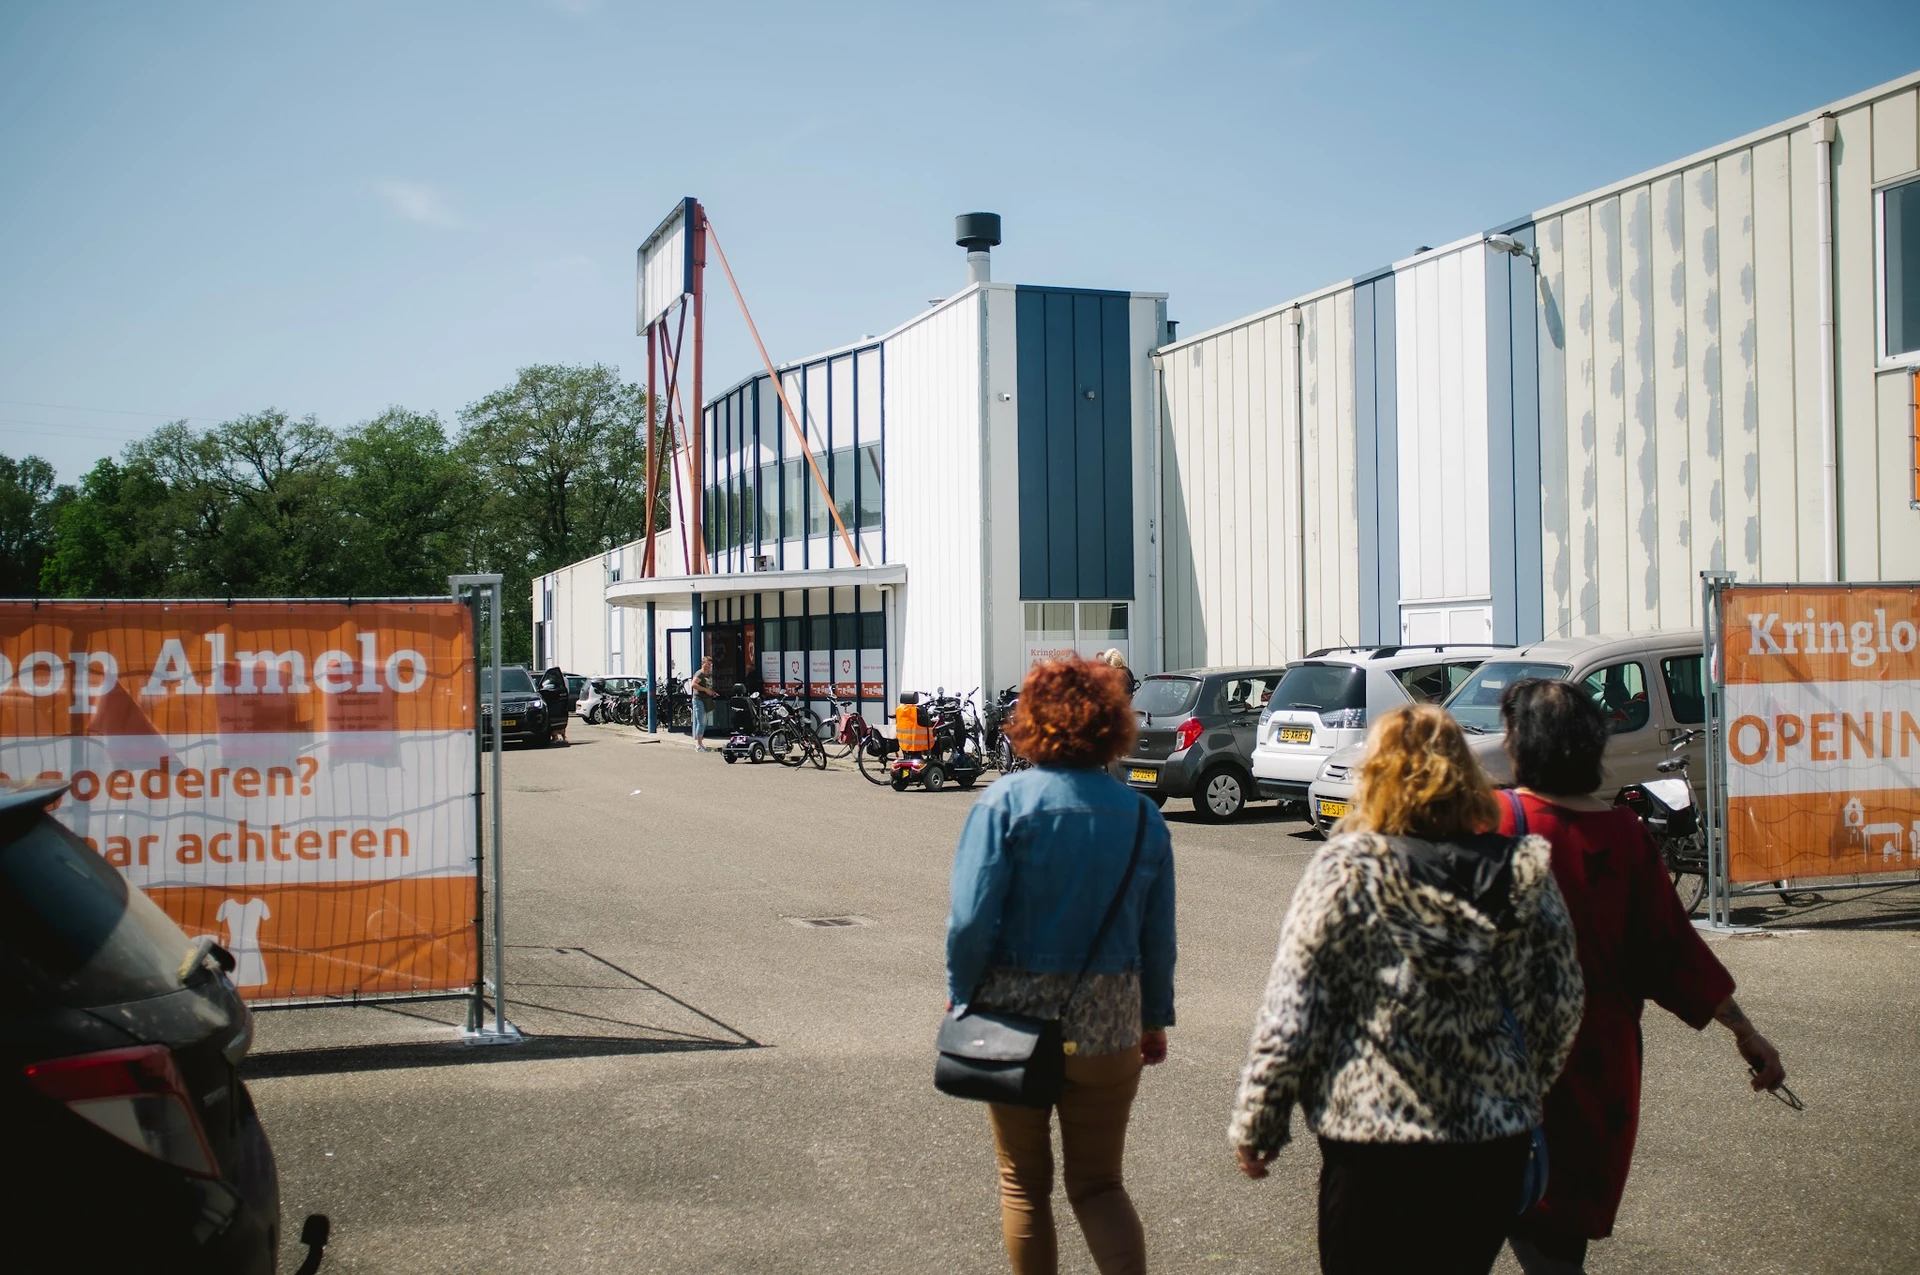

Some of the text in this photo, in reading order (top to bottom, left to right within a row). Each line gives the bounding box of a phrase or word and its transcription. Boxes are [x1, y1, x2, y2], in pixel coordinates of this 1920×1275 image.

[0, 633, 427, 714] op Almelo
[1322, 803, 1347, 815] 49-SJ-T
[175, 821, 411, 865] achteren
